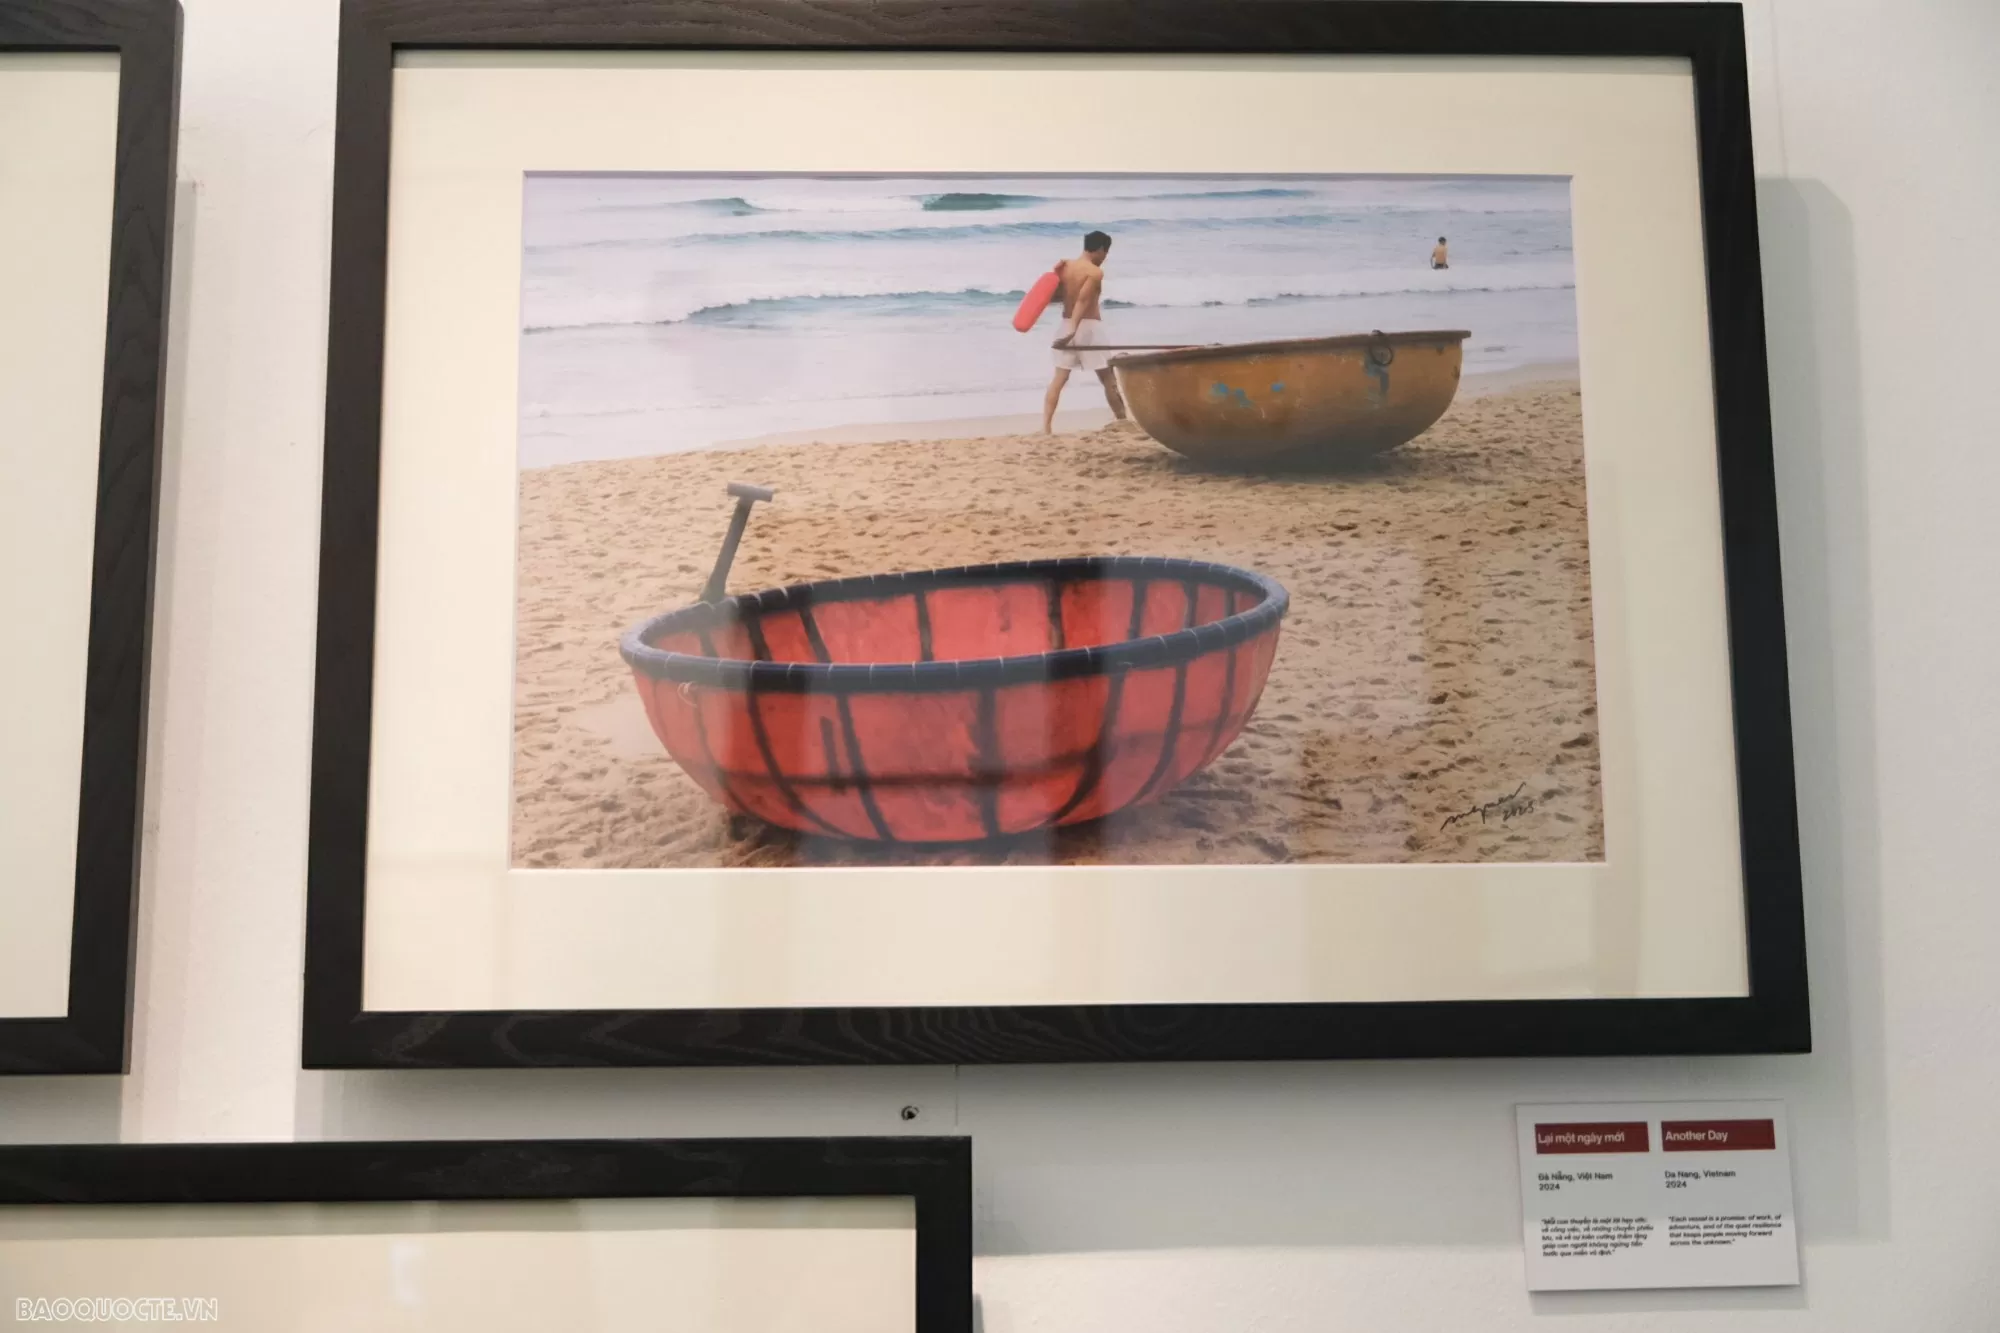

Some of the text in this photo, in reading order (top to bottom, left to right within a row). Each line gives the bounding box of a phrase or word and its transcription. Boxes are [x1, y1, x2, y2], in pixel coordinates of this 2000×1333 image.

[1538, 1131, 1625, 1146] Lại một ngày mới
[1665, 1130, 1728, 1142] Another Day
[1577, 1172, 1592, 1181] Việt
[1679, 1170, 1702, 1180] Nang,
[1703, 1170, 1736, 1178] Vietnam
